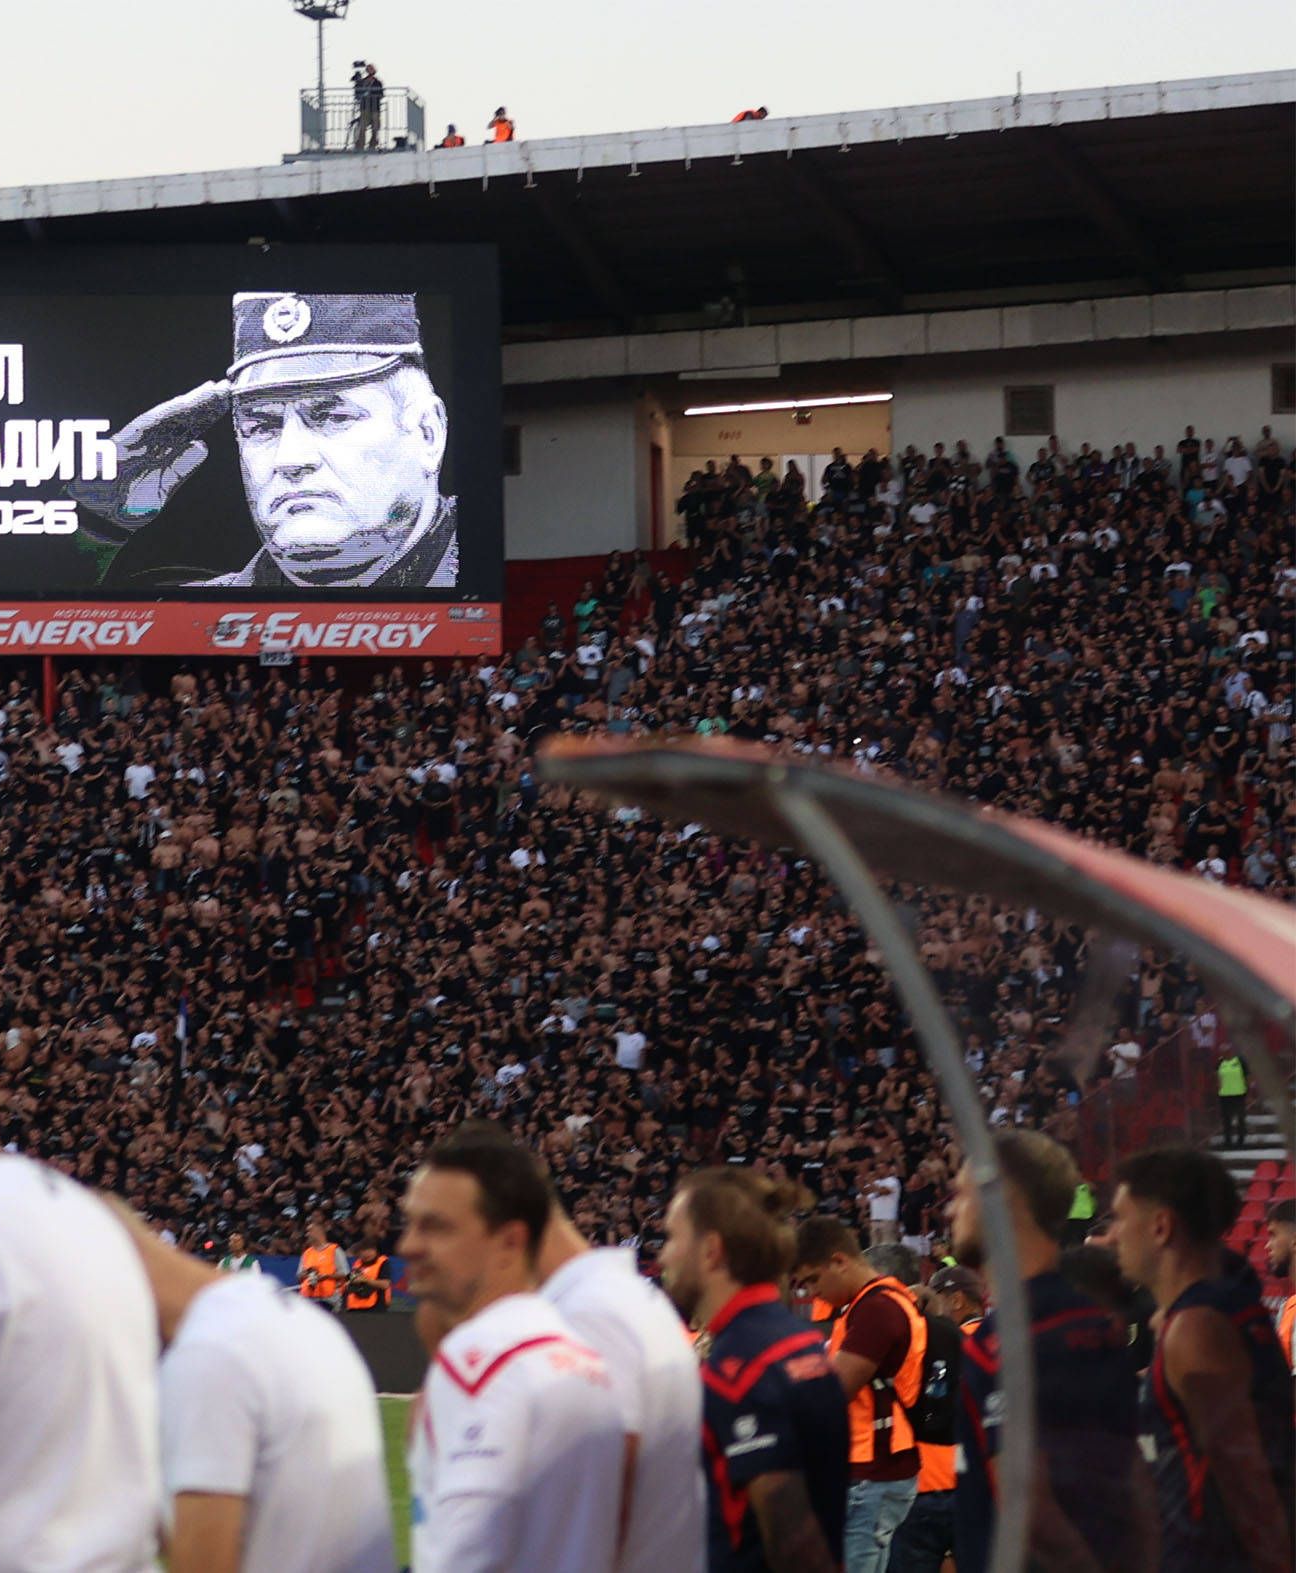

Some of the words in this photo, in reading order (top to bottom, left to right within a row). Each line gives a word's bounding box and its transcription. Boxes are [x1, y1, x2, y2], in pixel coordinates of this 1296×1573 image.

[53, 608, 120, 619] MOTORNO
[121, 609, 156, 620] ULJE
[334, 611, 402, 622] MOTORNO
[404, 611, 439, 622] ULJE
